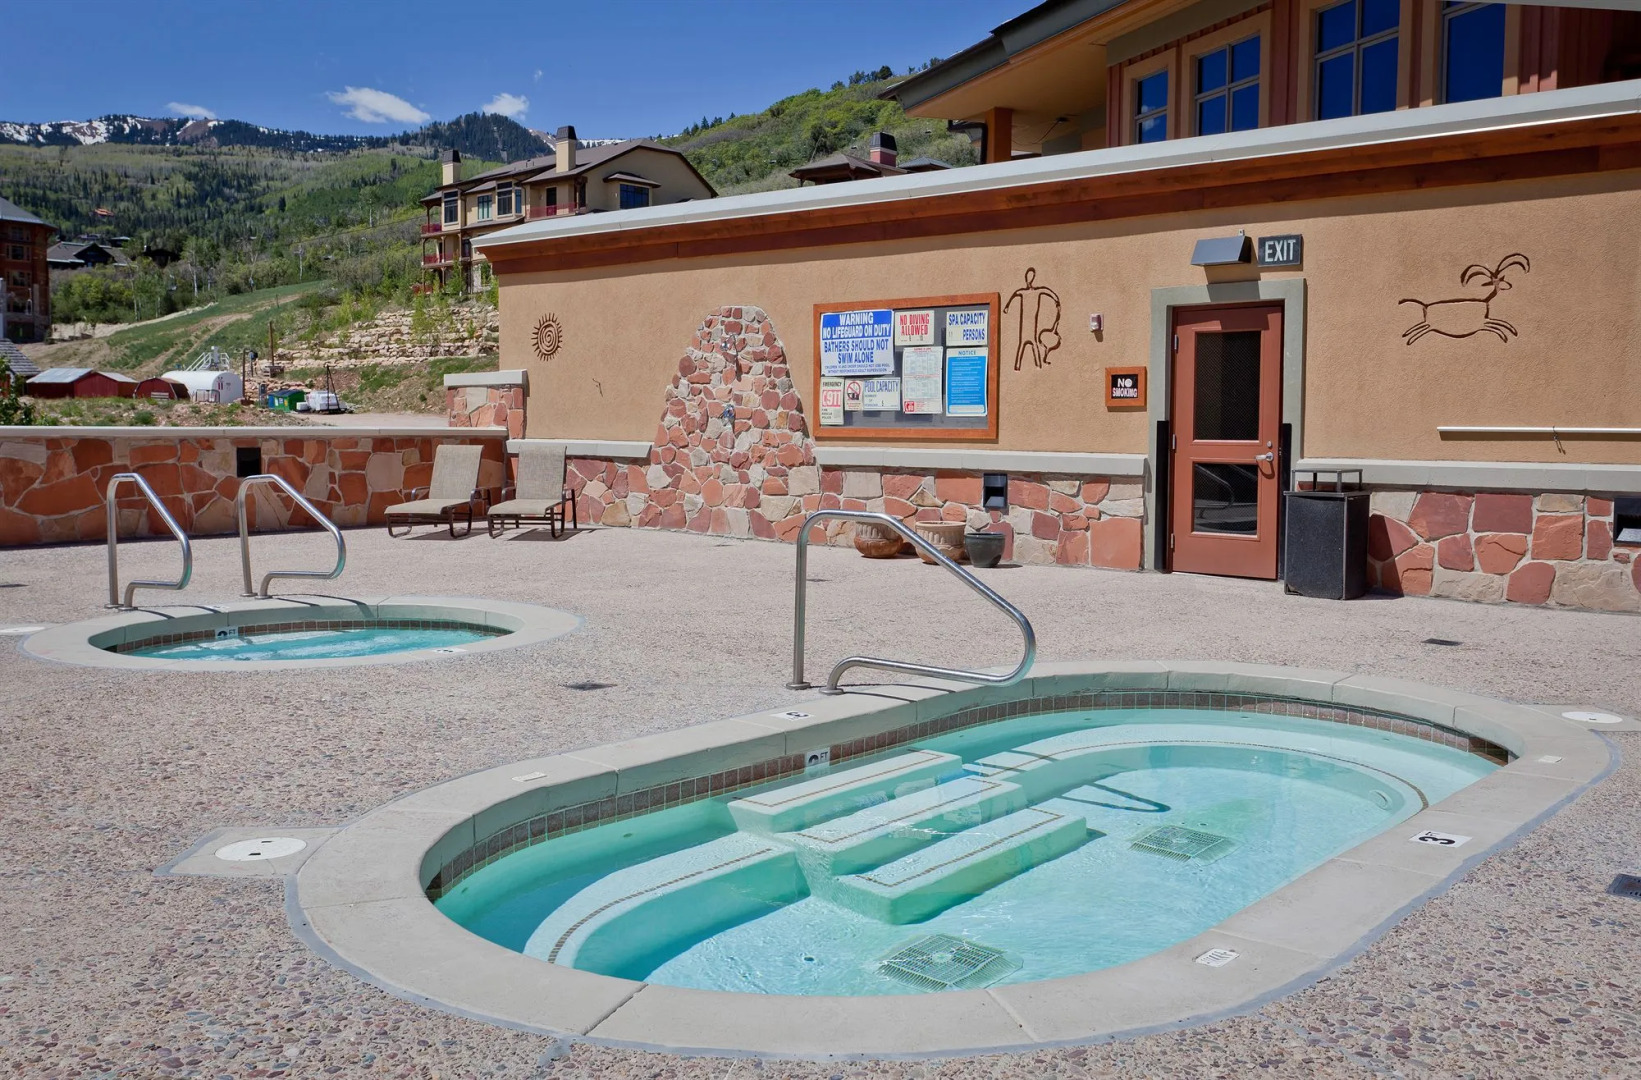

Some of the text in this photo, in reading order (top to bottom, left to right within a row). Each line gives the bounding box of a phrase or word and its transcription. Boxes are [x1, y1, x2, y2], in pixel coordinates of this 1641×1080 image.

[1264, 238, 1296, 262] EXIT
[839, 312, 874, 325] WARNING
[900, 313, 930, 325] NO DIVING
[948, 312, 985, 326] SPA CAPACITY
[822, 323, 890, 339] NO LIFEGUARD ON DUTY
[901, 325, 928, 336] ALLOWED
[963, 328, 985, 340] PERSONS
[824, 340, 850, 352] BATHERS
[851, 339, 874, 352] SHOULD
[876, 338, 889, 350] NOT
[838, 352, 874, 364] SWIM ALONE
[864, 381, 876, 392] POOL
[876, 380, 898, 392] CAPACITY
[1117, 378, 1133, 387] NO
[827, 390, 840, 405] 911
[1112, 387, 1138, 398] SMOKING
[1419, 836, 1455, 844] 3
